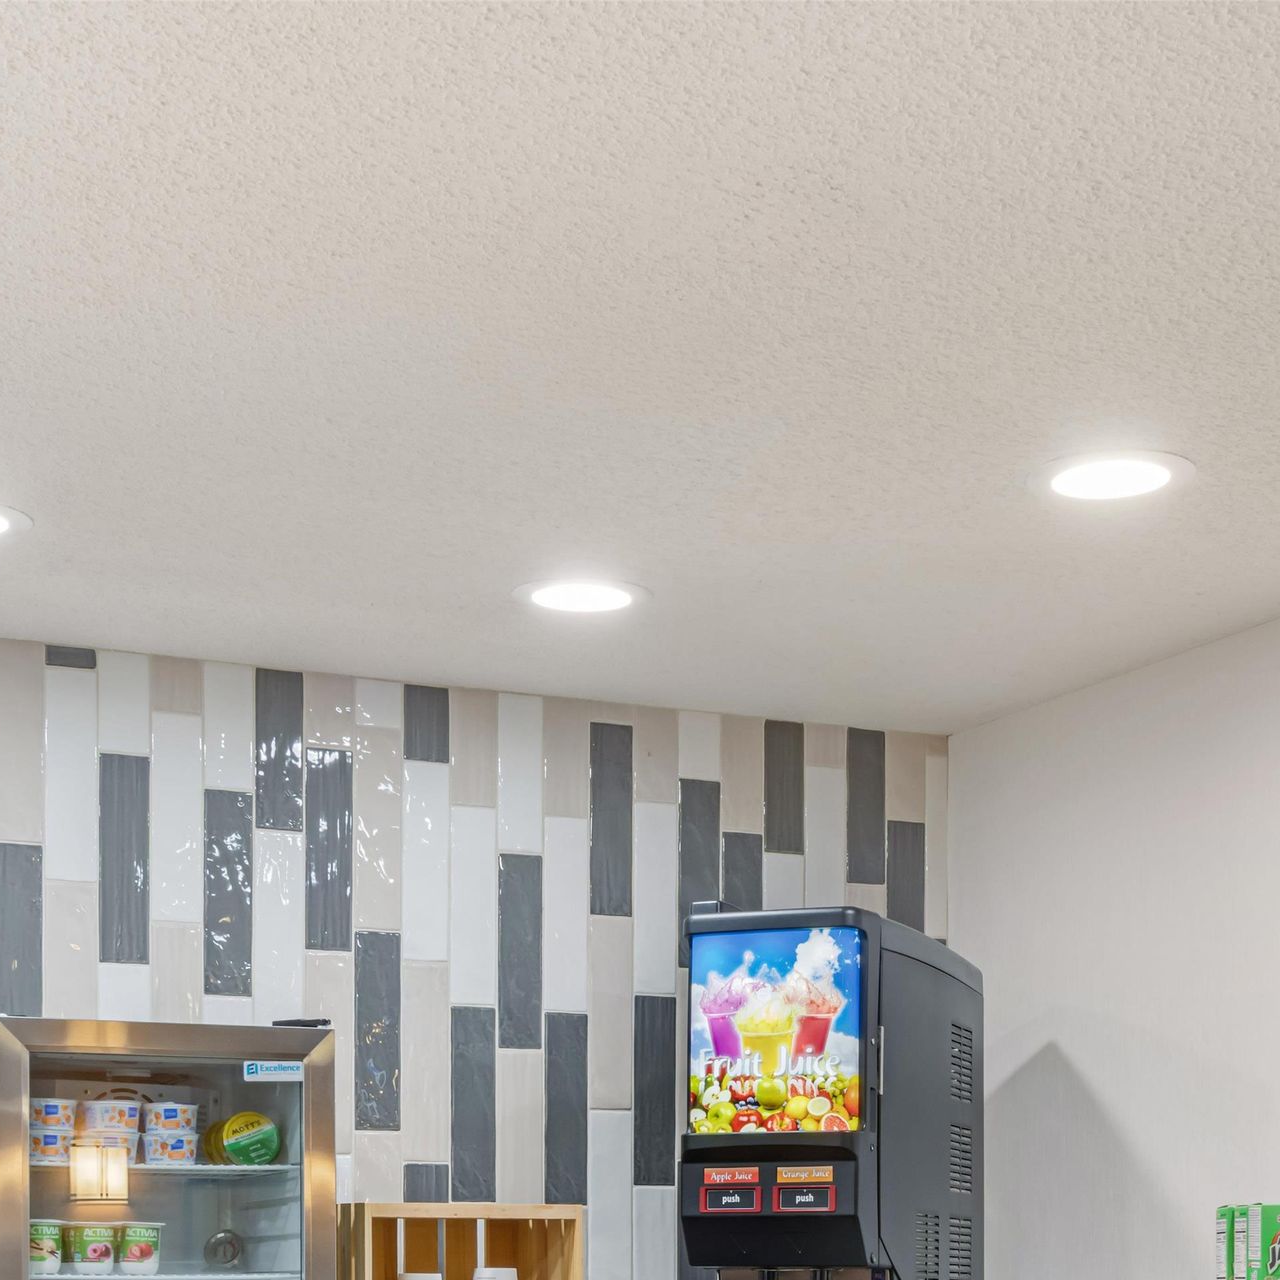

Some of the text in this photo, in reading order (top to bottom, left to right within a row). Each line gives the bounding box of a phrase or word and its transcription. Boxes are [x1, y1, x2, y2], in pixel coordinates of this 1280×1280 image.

[260, 1064, 300, 1072] Excellence
[699, 1046, 841, 1078] Fruit Juice
[710, 1171, 752, 1183] Apple Juice
[782, 1168, 830, 1181] Orange Juice
[722, 1193, 740, 1205] push
[795, 1193, 814, 1205] push
[31, 1226, 59, 1235] CTIVIA
